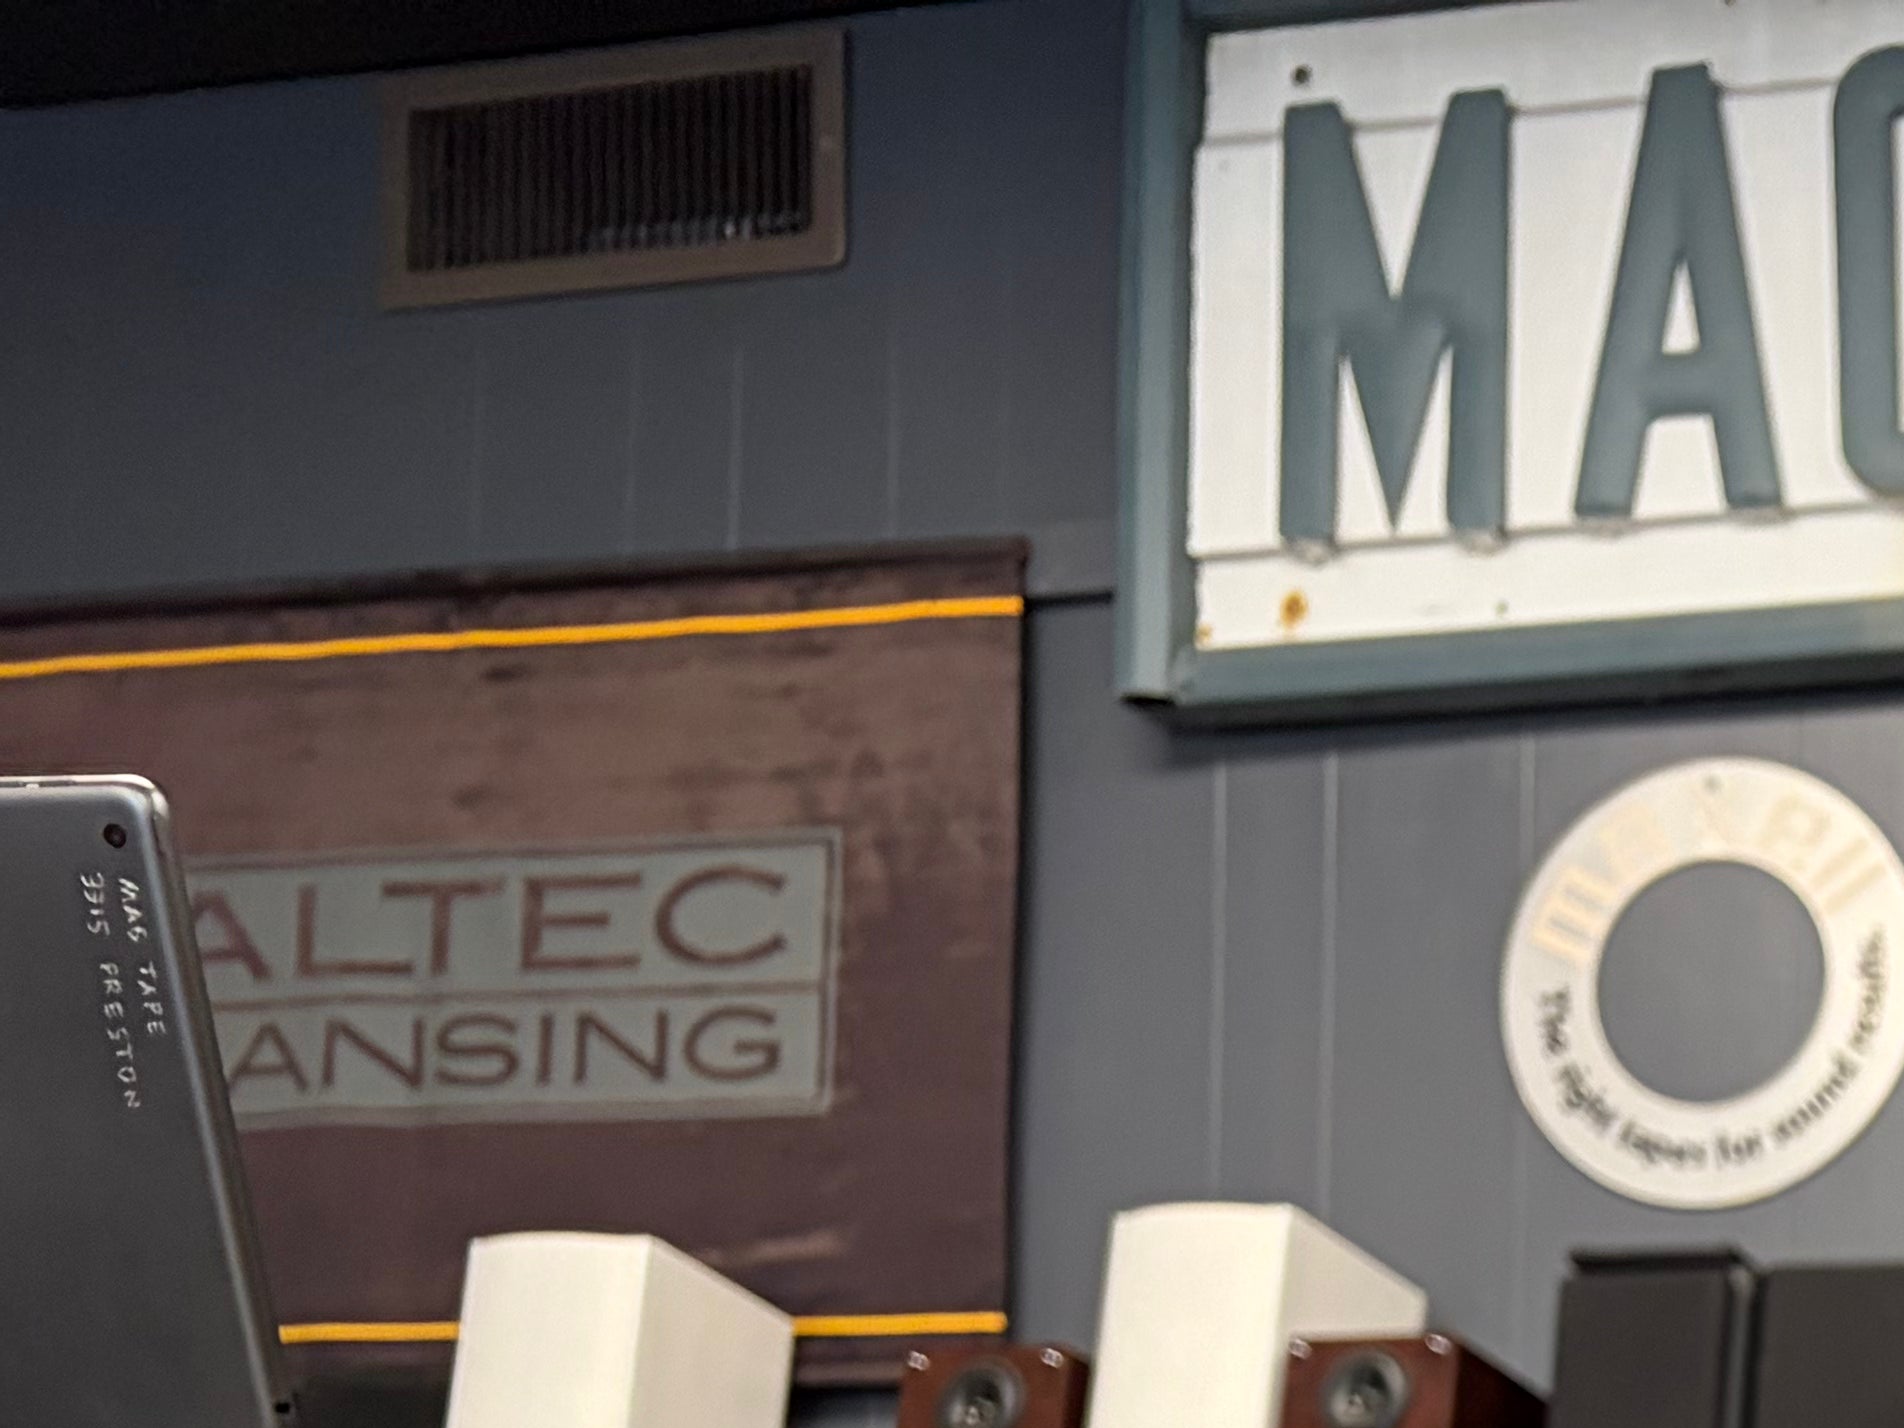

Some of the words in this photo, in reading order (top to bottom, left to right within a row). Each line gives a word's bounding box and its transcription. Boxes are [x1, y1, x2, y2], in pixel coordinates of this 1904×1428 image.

[118, 877, 148, 942] MAG
[137, 961, 166, 1034] TAPE
[192, 864, 787, 980] ALTEC
[100, 962, 141, 1108] PRESTON
[229, 1006, 782, 1093] ANSING
